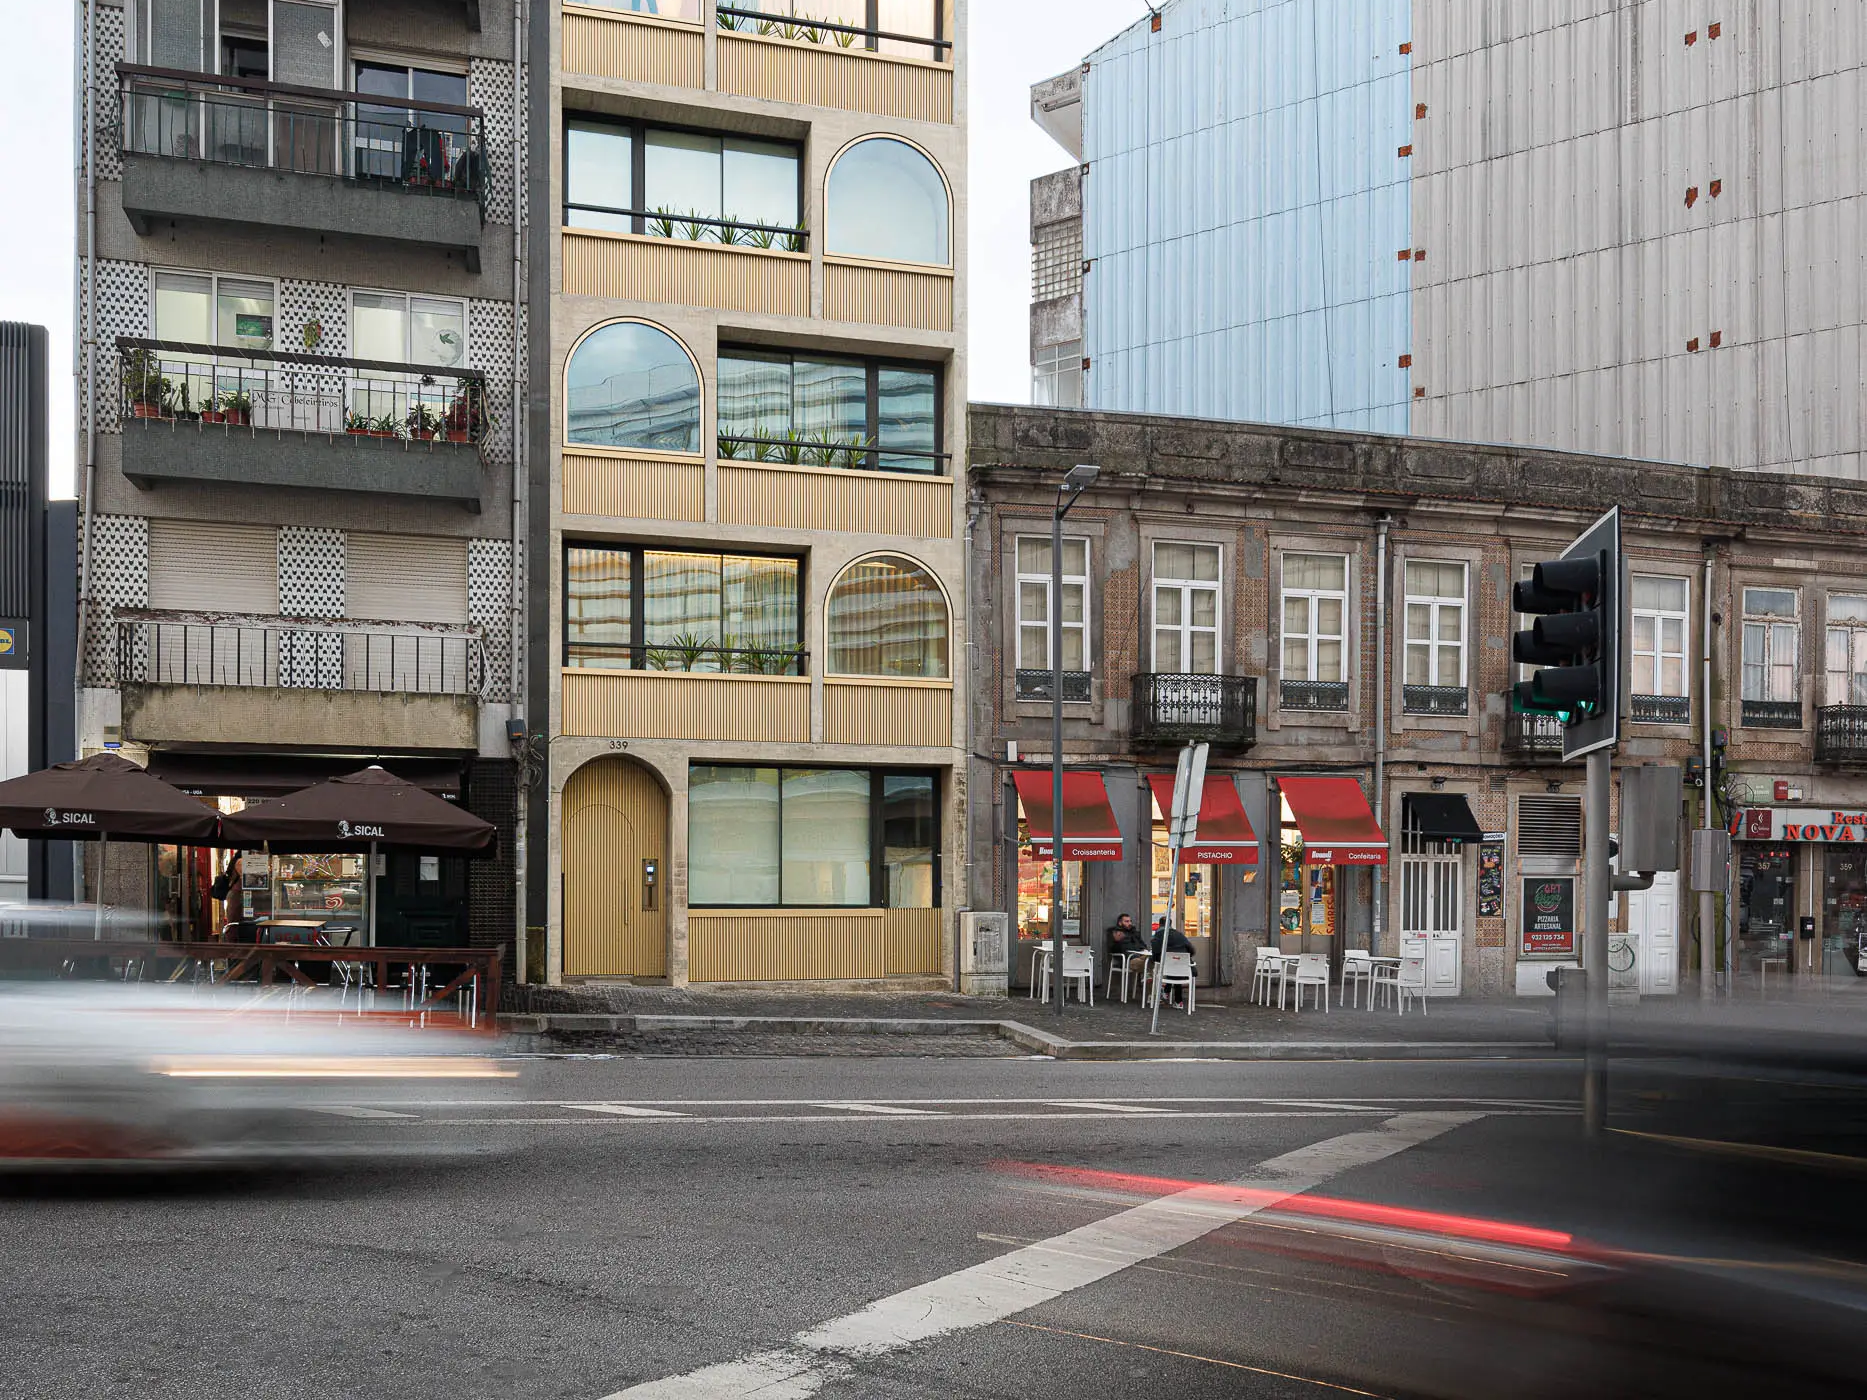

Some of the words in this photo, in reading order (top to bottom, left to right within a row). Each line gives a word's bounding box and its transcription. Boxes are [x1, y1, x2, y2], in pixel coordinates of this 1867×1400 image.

[609, 740, 629, 751] 339
[62, 812, 95, 824] SICAL
[354, 826, 384, 837] SICAL
[1785, 824, 1856, 841] NOVA
[1072, 848, 1116, 856] Croissanteria
[1348, 852, 1381, 860] Confeitaria
[1758, 862, 1771, 870] 357
[1839, 863, 1853, 871] 359
[1537, 915, 1559, 923] PIZZARIA
